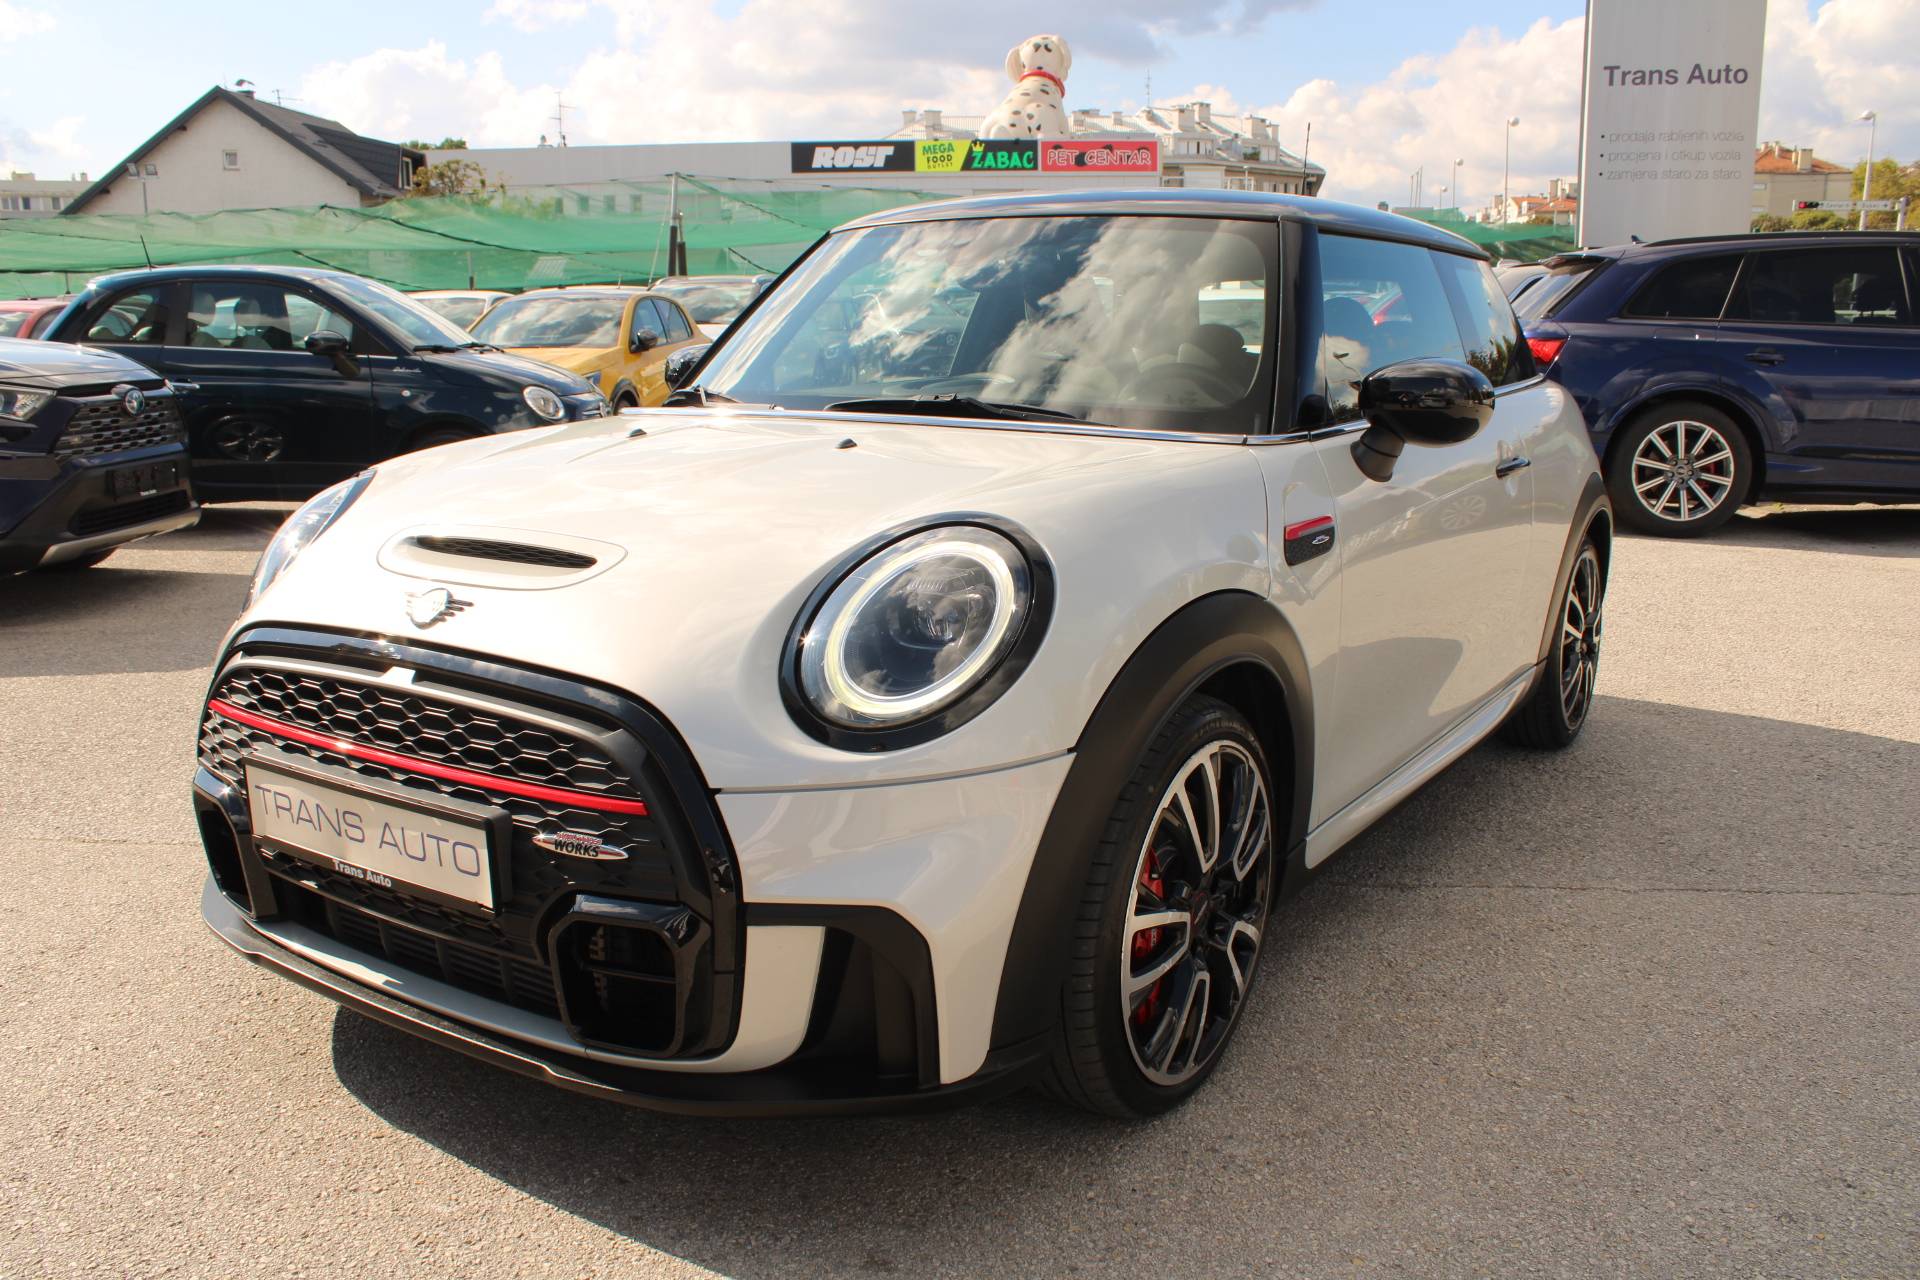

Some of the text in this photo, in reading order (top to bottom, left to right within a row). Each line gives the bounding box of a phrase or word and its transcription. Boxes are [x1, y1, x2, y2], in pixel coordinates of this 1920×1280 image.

[1603, 63, 1748, 86] Trans Auto
[812, 146, 895, 168] ROST
[922, 142, 955, 155] MEGA
[1048, 149, 1151, 166] PET CENTAR
[926, 154, 953, 165] FOOD
[254, 785, 481, 878] TRANS AUTO
[554, 839, 600, 857] WORKS
[333, 859, 392, 888] Trans Auto
